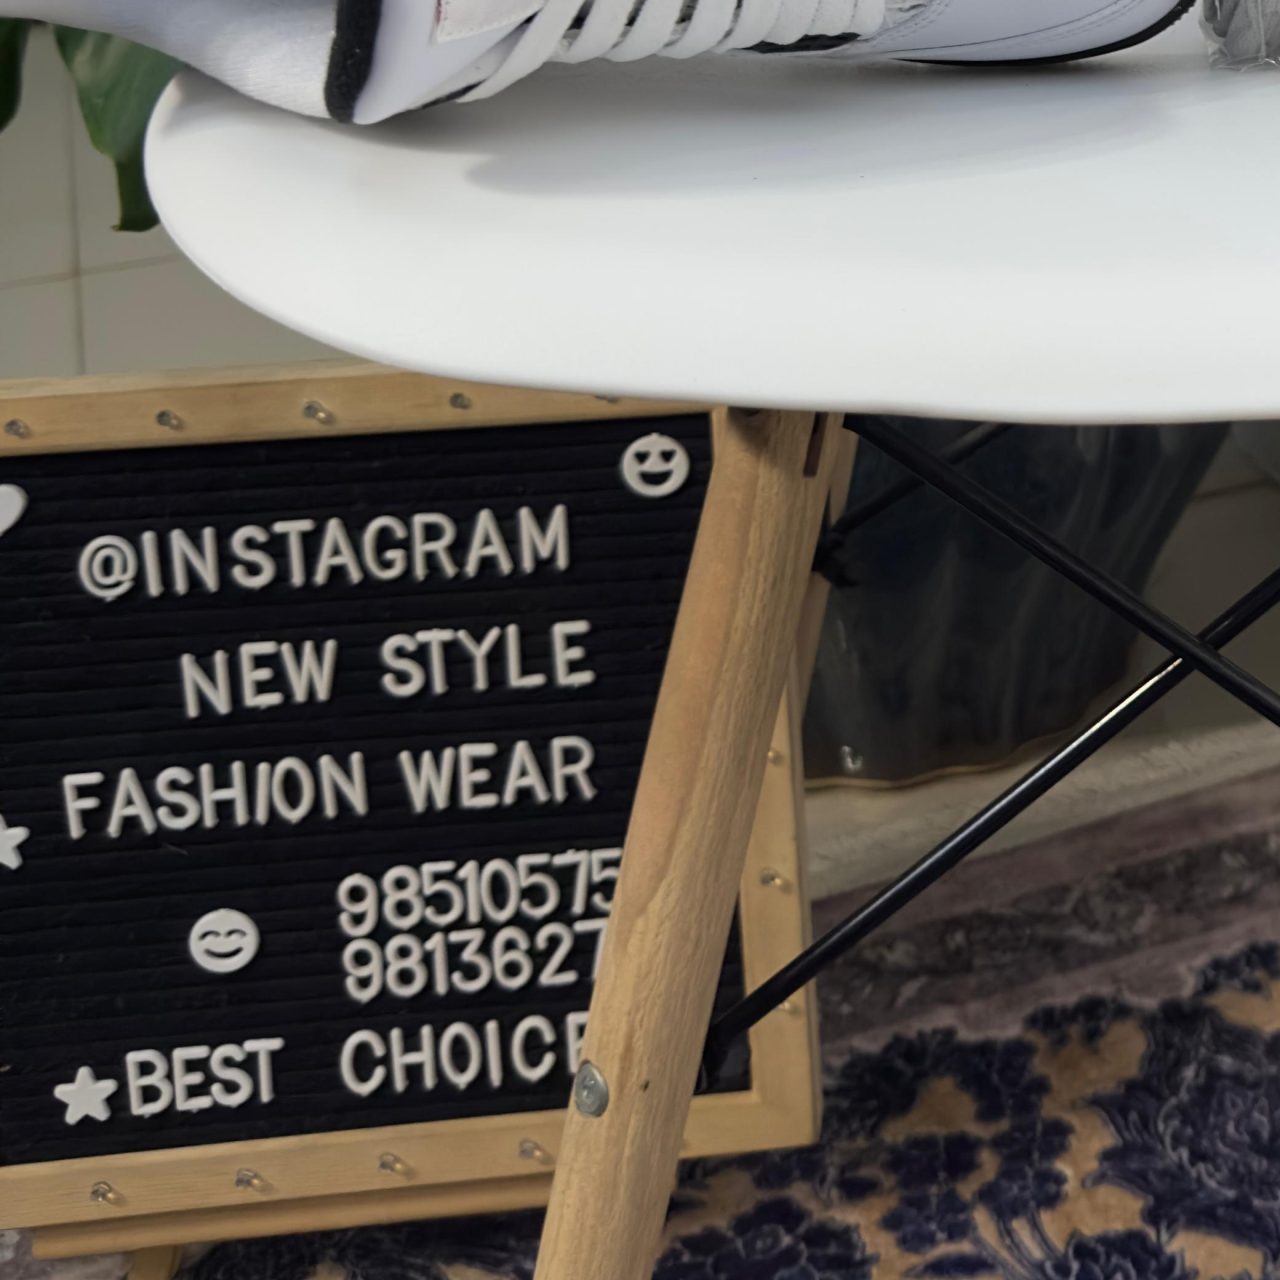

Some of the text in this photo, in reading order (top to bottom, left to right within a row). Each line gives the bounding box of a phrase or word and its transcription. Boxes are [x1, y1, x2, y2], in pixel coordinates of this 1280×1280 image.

[78, 504, 570, 601] @INSTAGRAM
[180, 619, 597, 718] NEW STYLE
[62, 735, 599, 840] FASHION WEAR
[337, 848, 623, 938] 98510575
[126, 1038, 285, 1117] BEST
